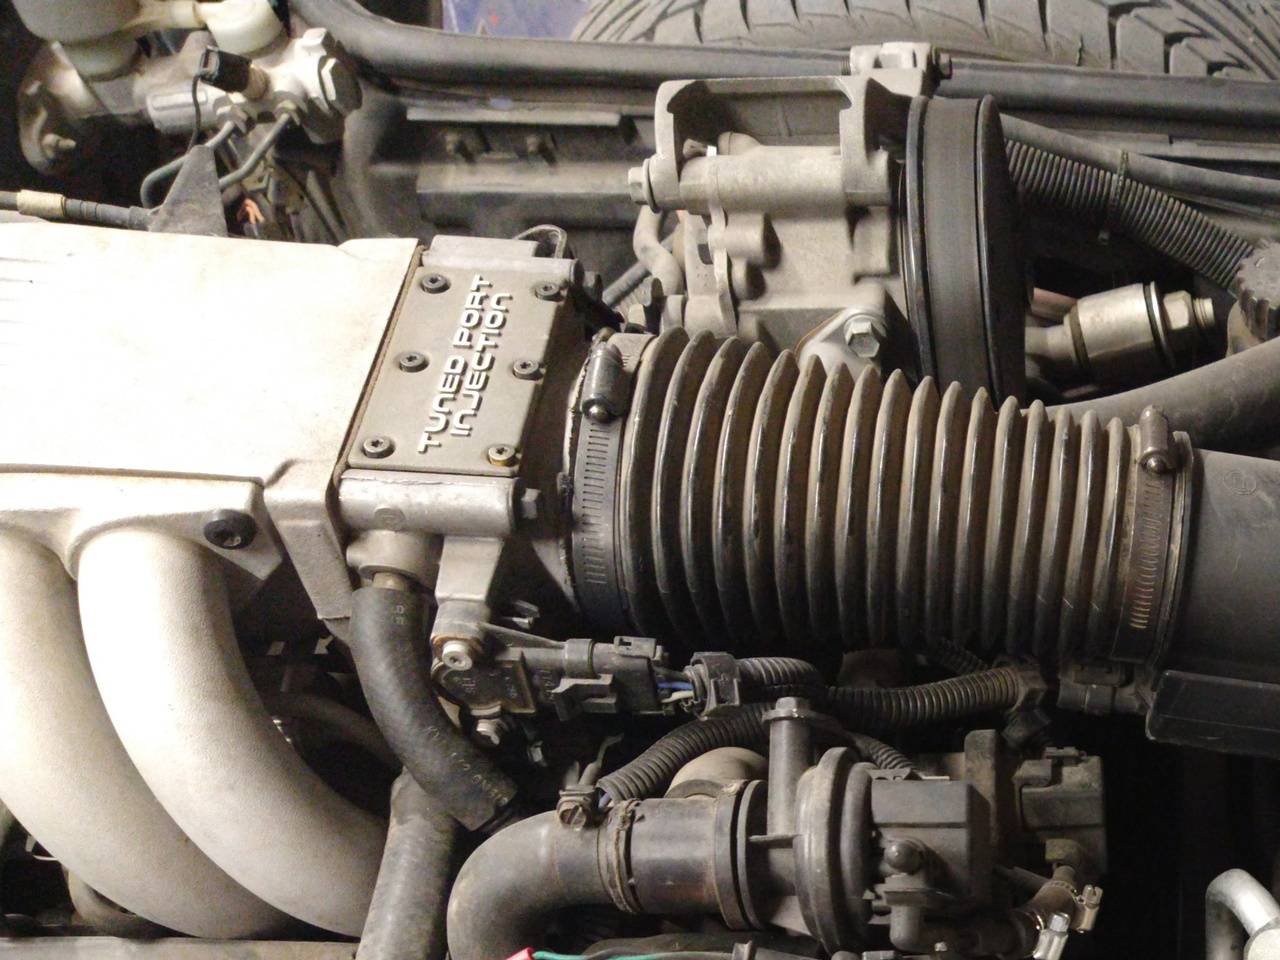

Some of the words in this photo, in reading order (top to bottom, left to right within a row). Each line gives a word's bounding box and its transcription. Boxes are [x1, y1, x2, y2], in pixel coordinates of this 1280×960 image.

[417, 354, 466, 453] TUNED
[452, 273, 493, 348] PORT
[450, 291, 513, 437] INJECTION
